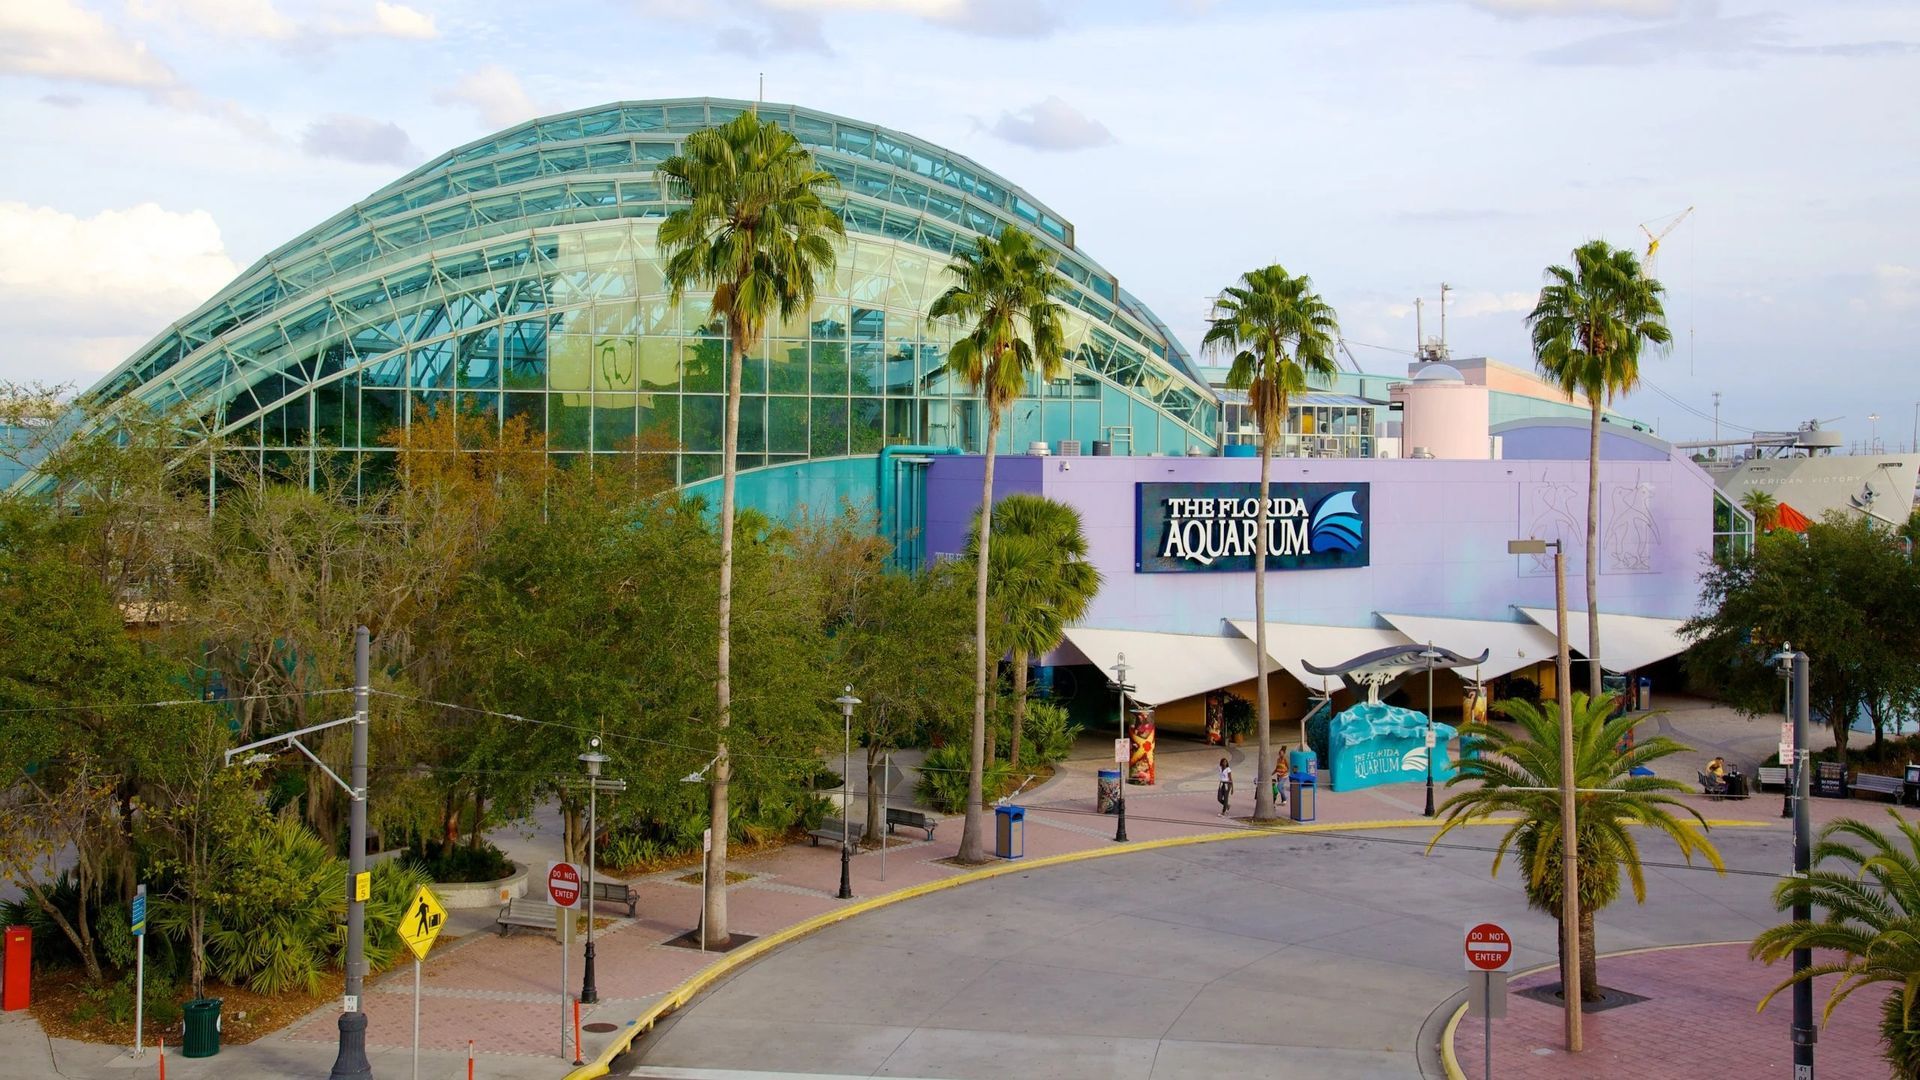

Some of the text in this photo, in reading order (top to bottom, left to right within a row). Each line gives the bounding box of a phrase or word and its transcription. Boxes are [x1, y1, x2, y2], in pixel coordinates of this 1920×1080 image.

[1743, 475, 1862, 486] AMERICAN VICTORY
[1168, 498, 1309, 518] THE FLORIDA
[553, 869, 576, 880] DO NOT
[361, 889, 366, 898] 5
[555, 889, 574, 899] ENTER
[1471, 932, 1505, 941] DO NOT
[1475, 953, 1502, 961] ENTER
